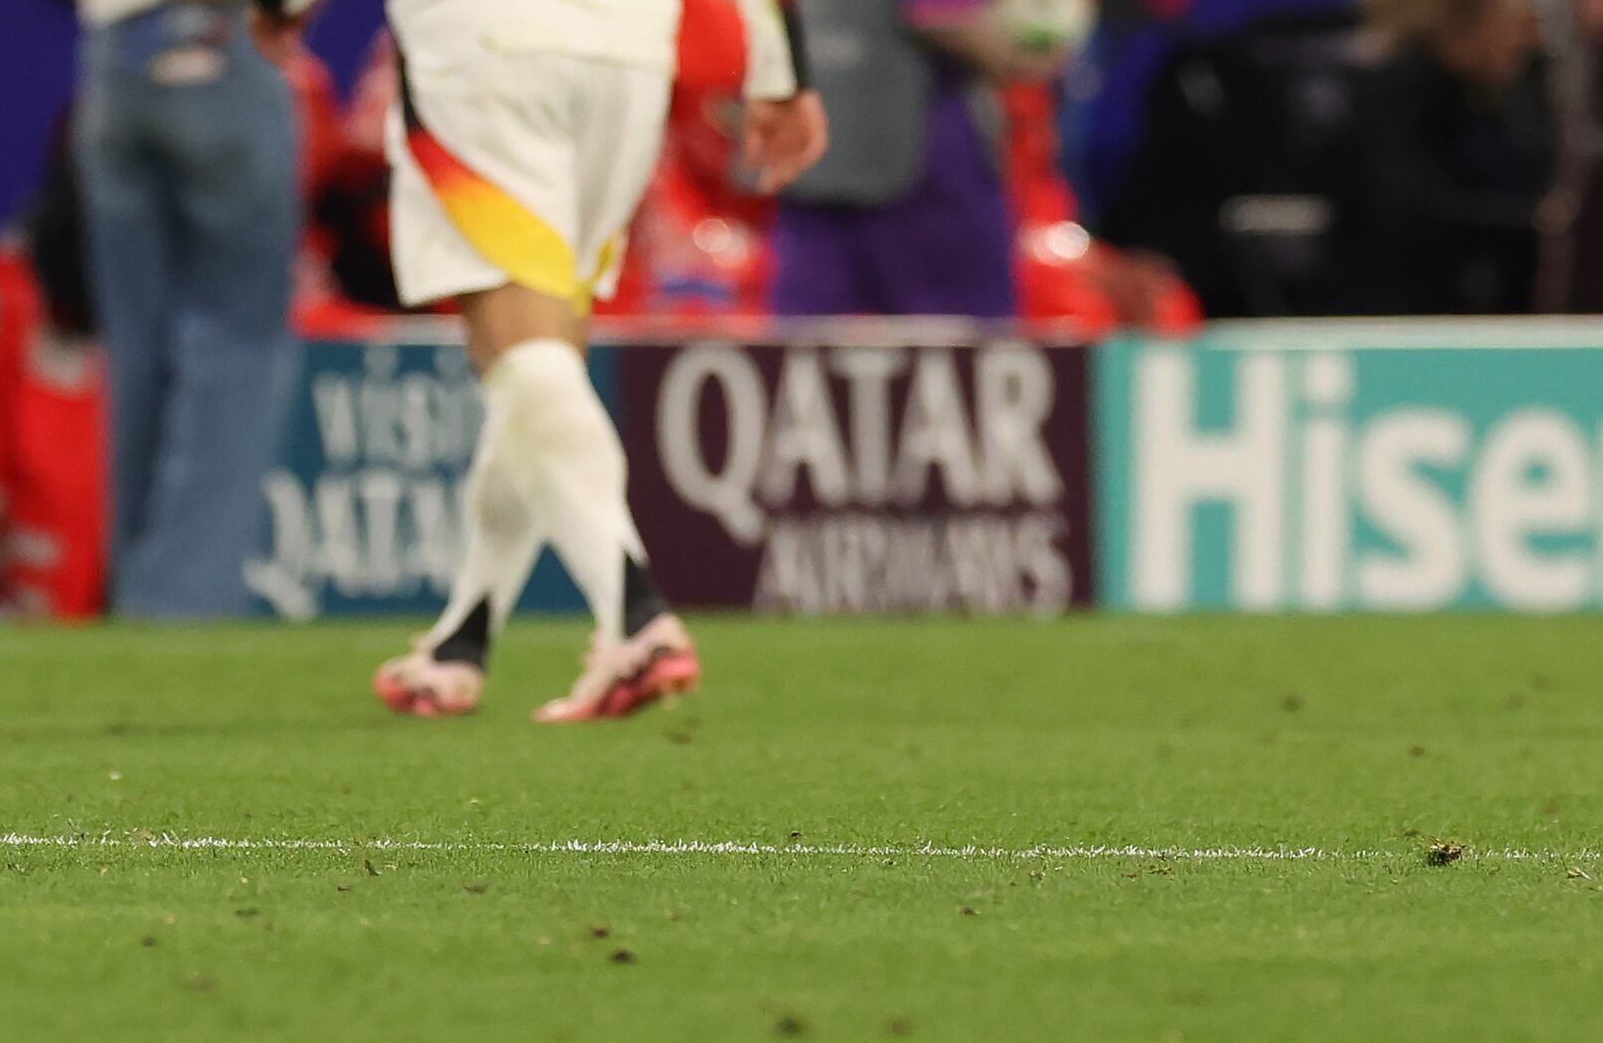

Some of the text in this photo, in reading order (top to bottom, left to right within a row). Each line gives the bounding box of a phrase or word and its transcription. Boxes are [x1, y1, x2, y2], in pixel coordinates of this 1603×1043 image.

[656, 343, 1064, 547] QATAR
[1130, 345, 1602, 614] Hise
[753, 513, 1072, 620] AIRWAYS
